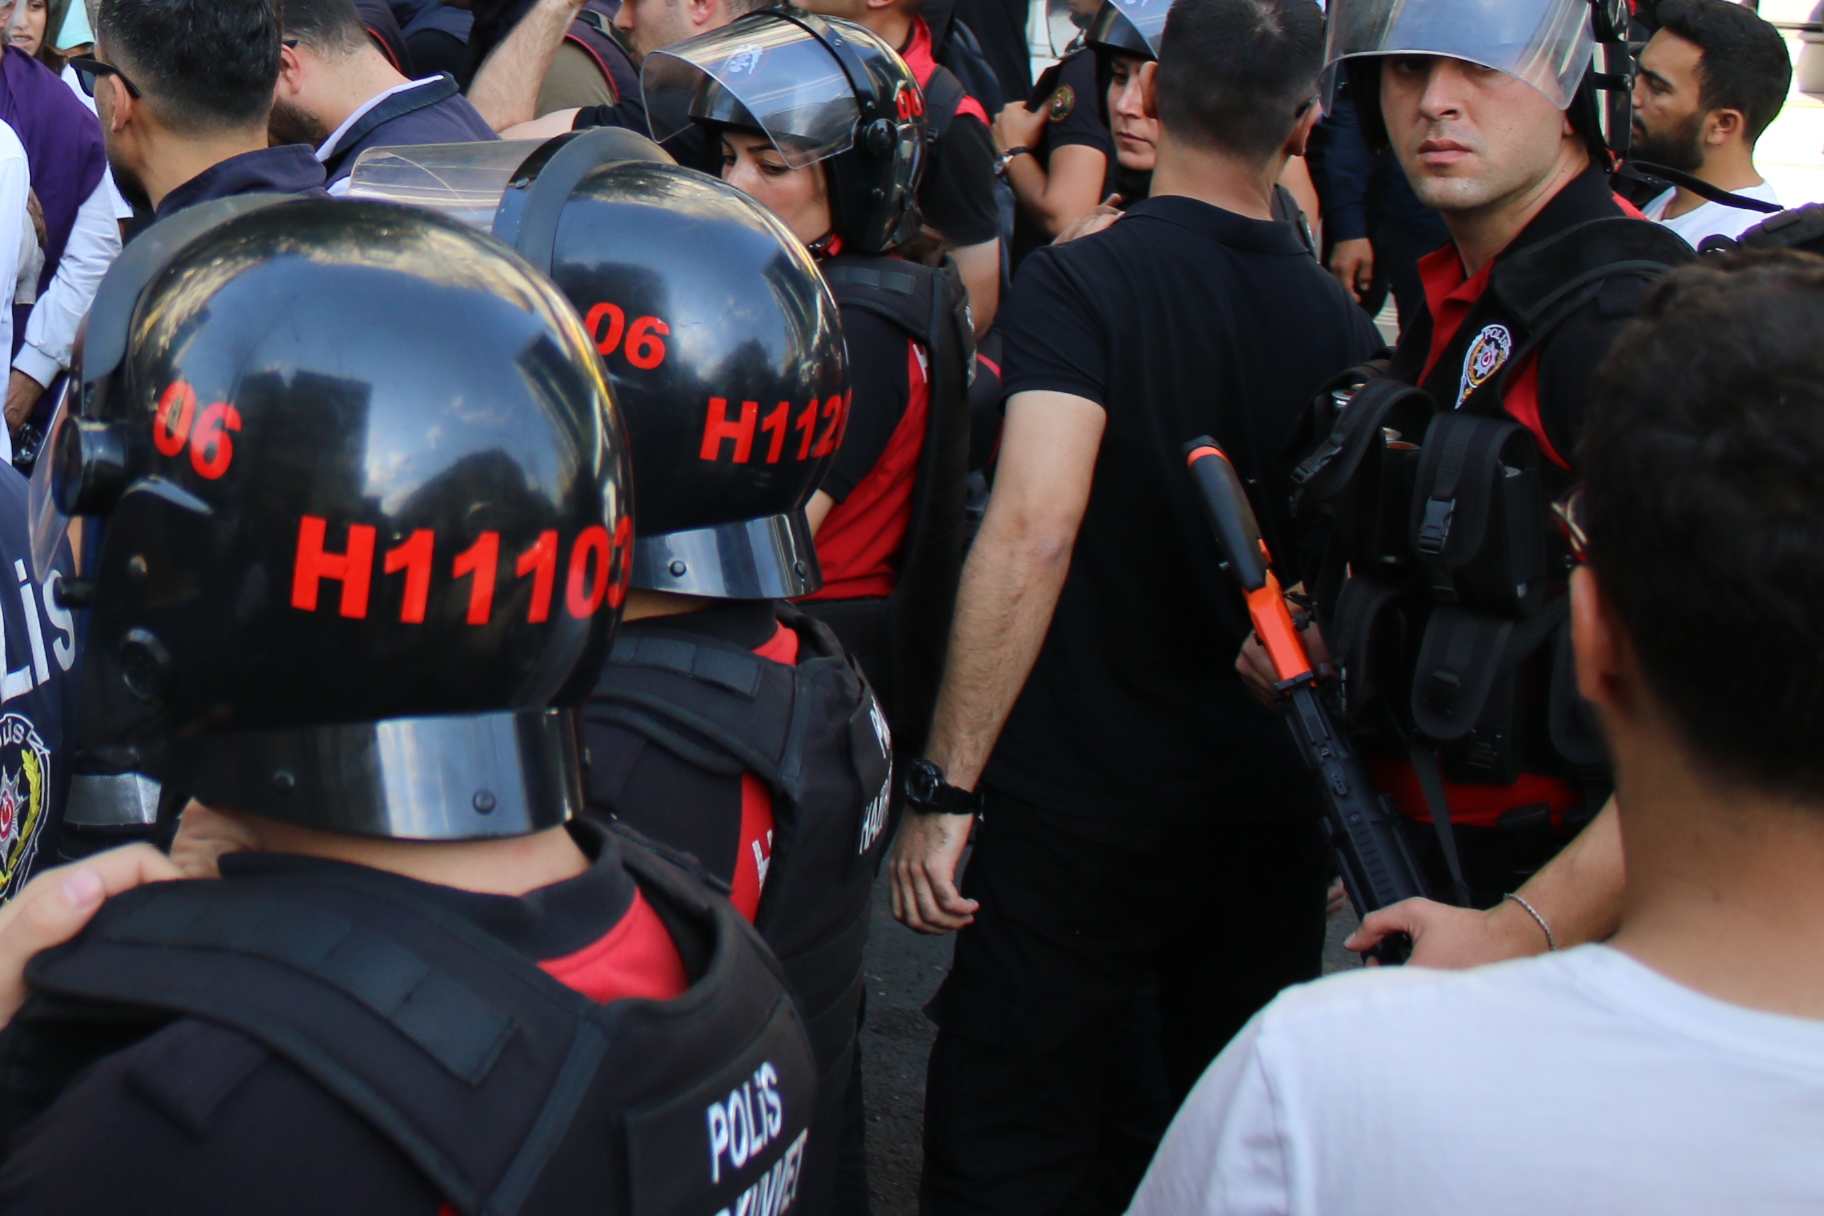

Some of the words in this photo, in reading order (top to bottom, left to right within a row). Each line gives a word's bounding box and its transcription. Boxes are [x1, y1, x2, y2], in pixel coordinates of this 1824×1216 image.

[583, 300, 671, 370] 06
[152, 379, 243, 481] 06
[699, 388, 853, 465] H112
[706, 1060, 783, 1184] POLİS
